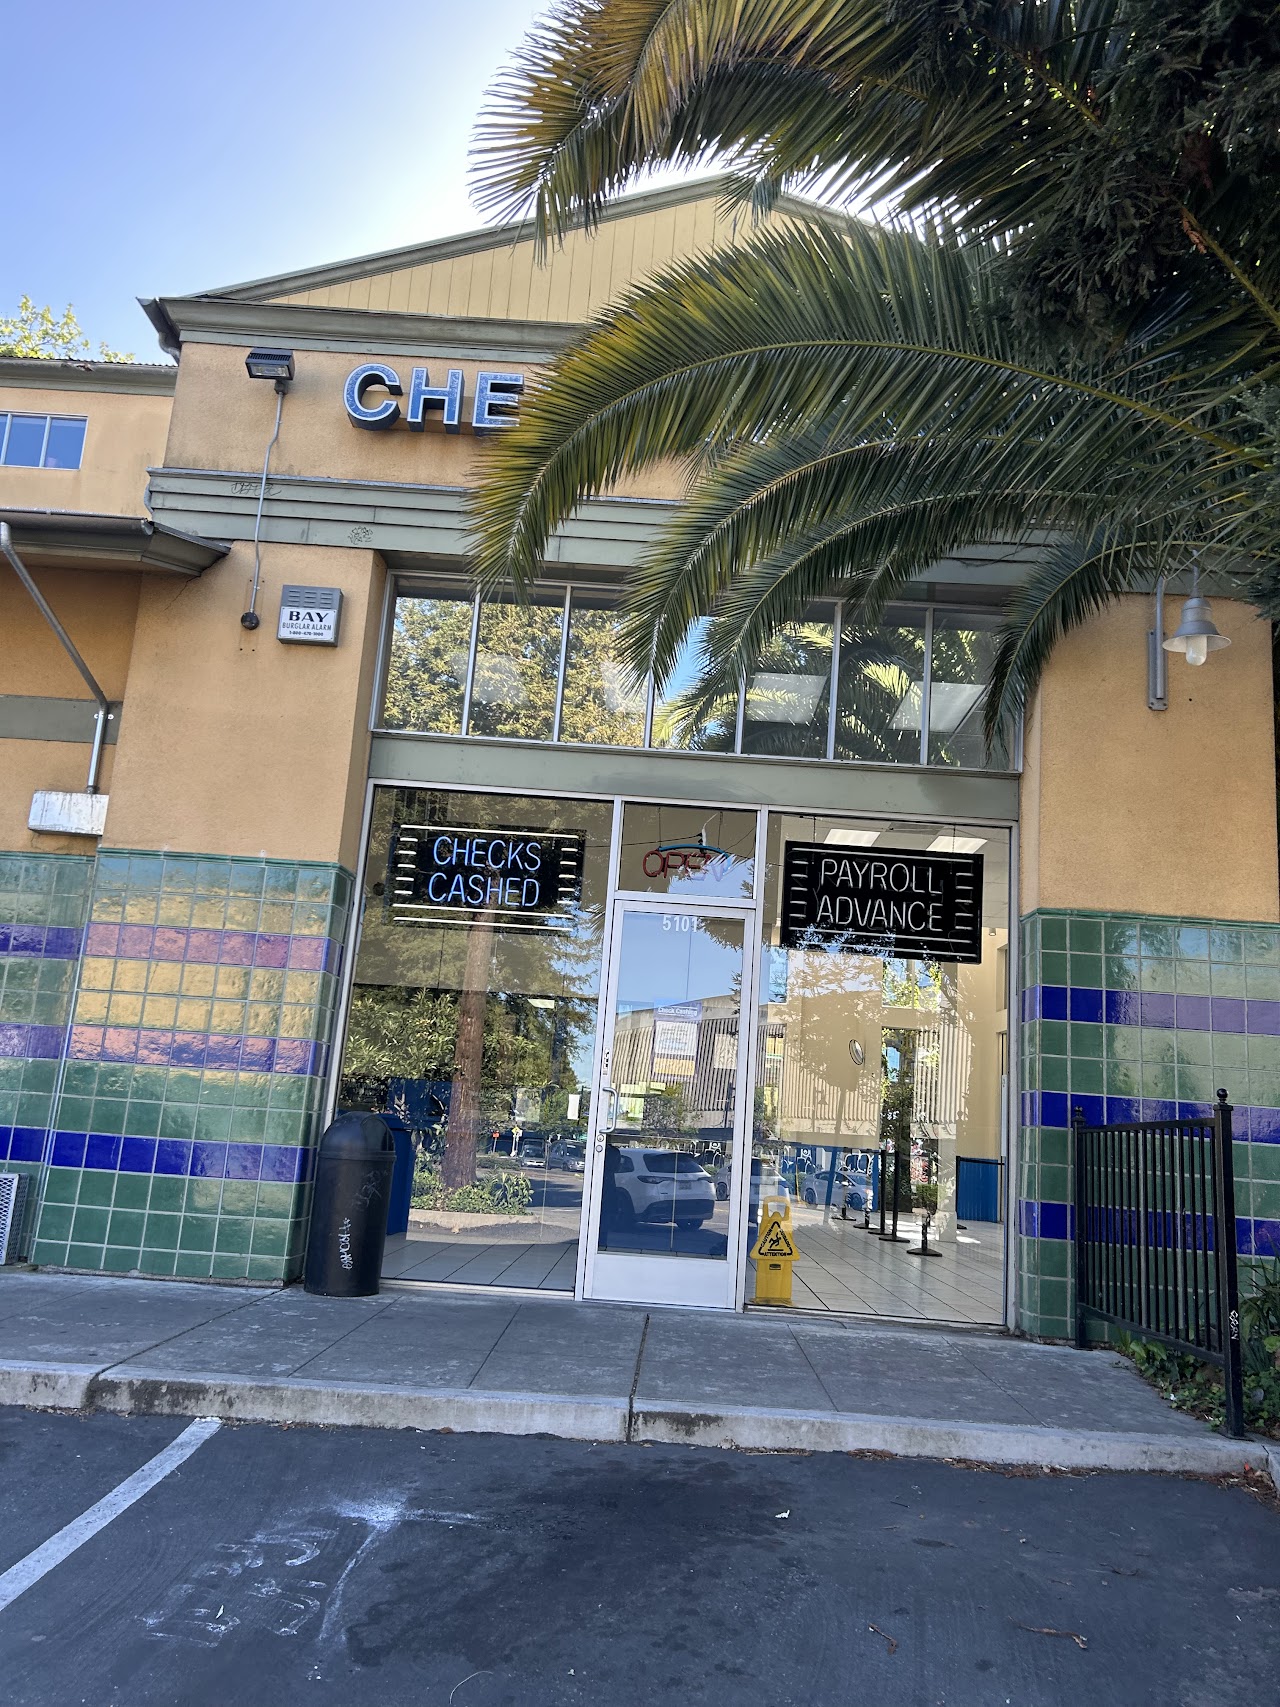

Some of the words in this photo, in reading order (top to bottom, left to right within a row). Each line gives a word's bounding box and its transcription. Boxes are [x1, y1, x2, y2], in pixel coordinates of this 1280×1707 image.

[343, 363, 525, 428] CHE
[289, 610, 329, 622] BAY
[433, 836, 542, 871] CHECKS
[428, 872, 540, 907] CASHED
[820, 858, 943, 895] PAYROLL
[662, 915, 698, 933] 5101
[816, 895, 944, 932] ADVANCE
[760, 1228, 773, 1248] CAUTION
